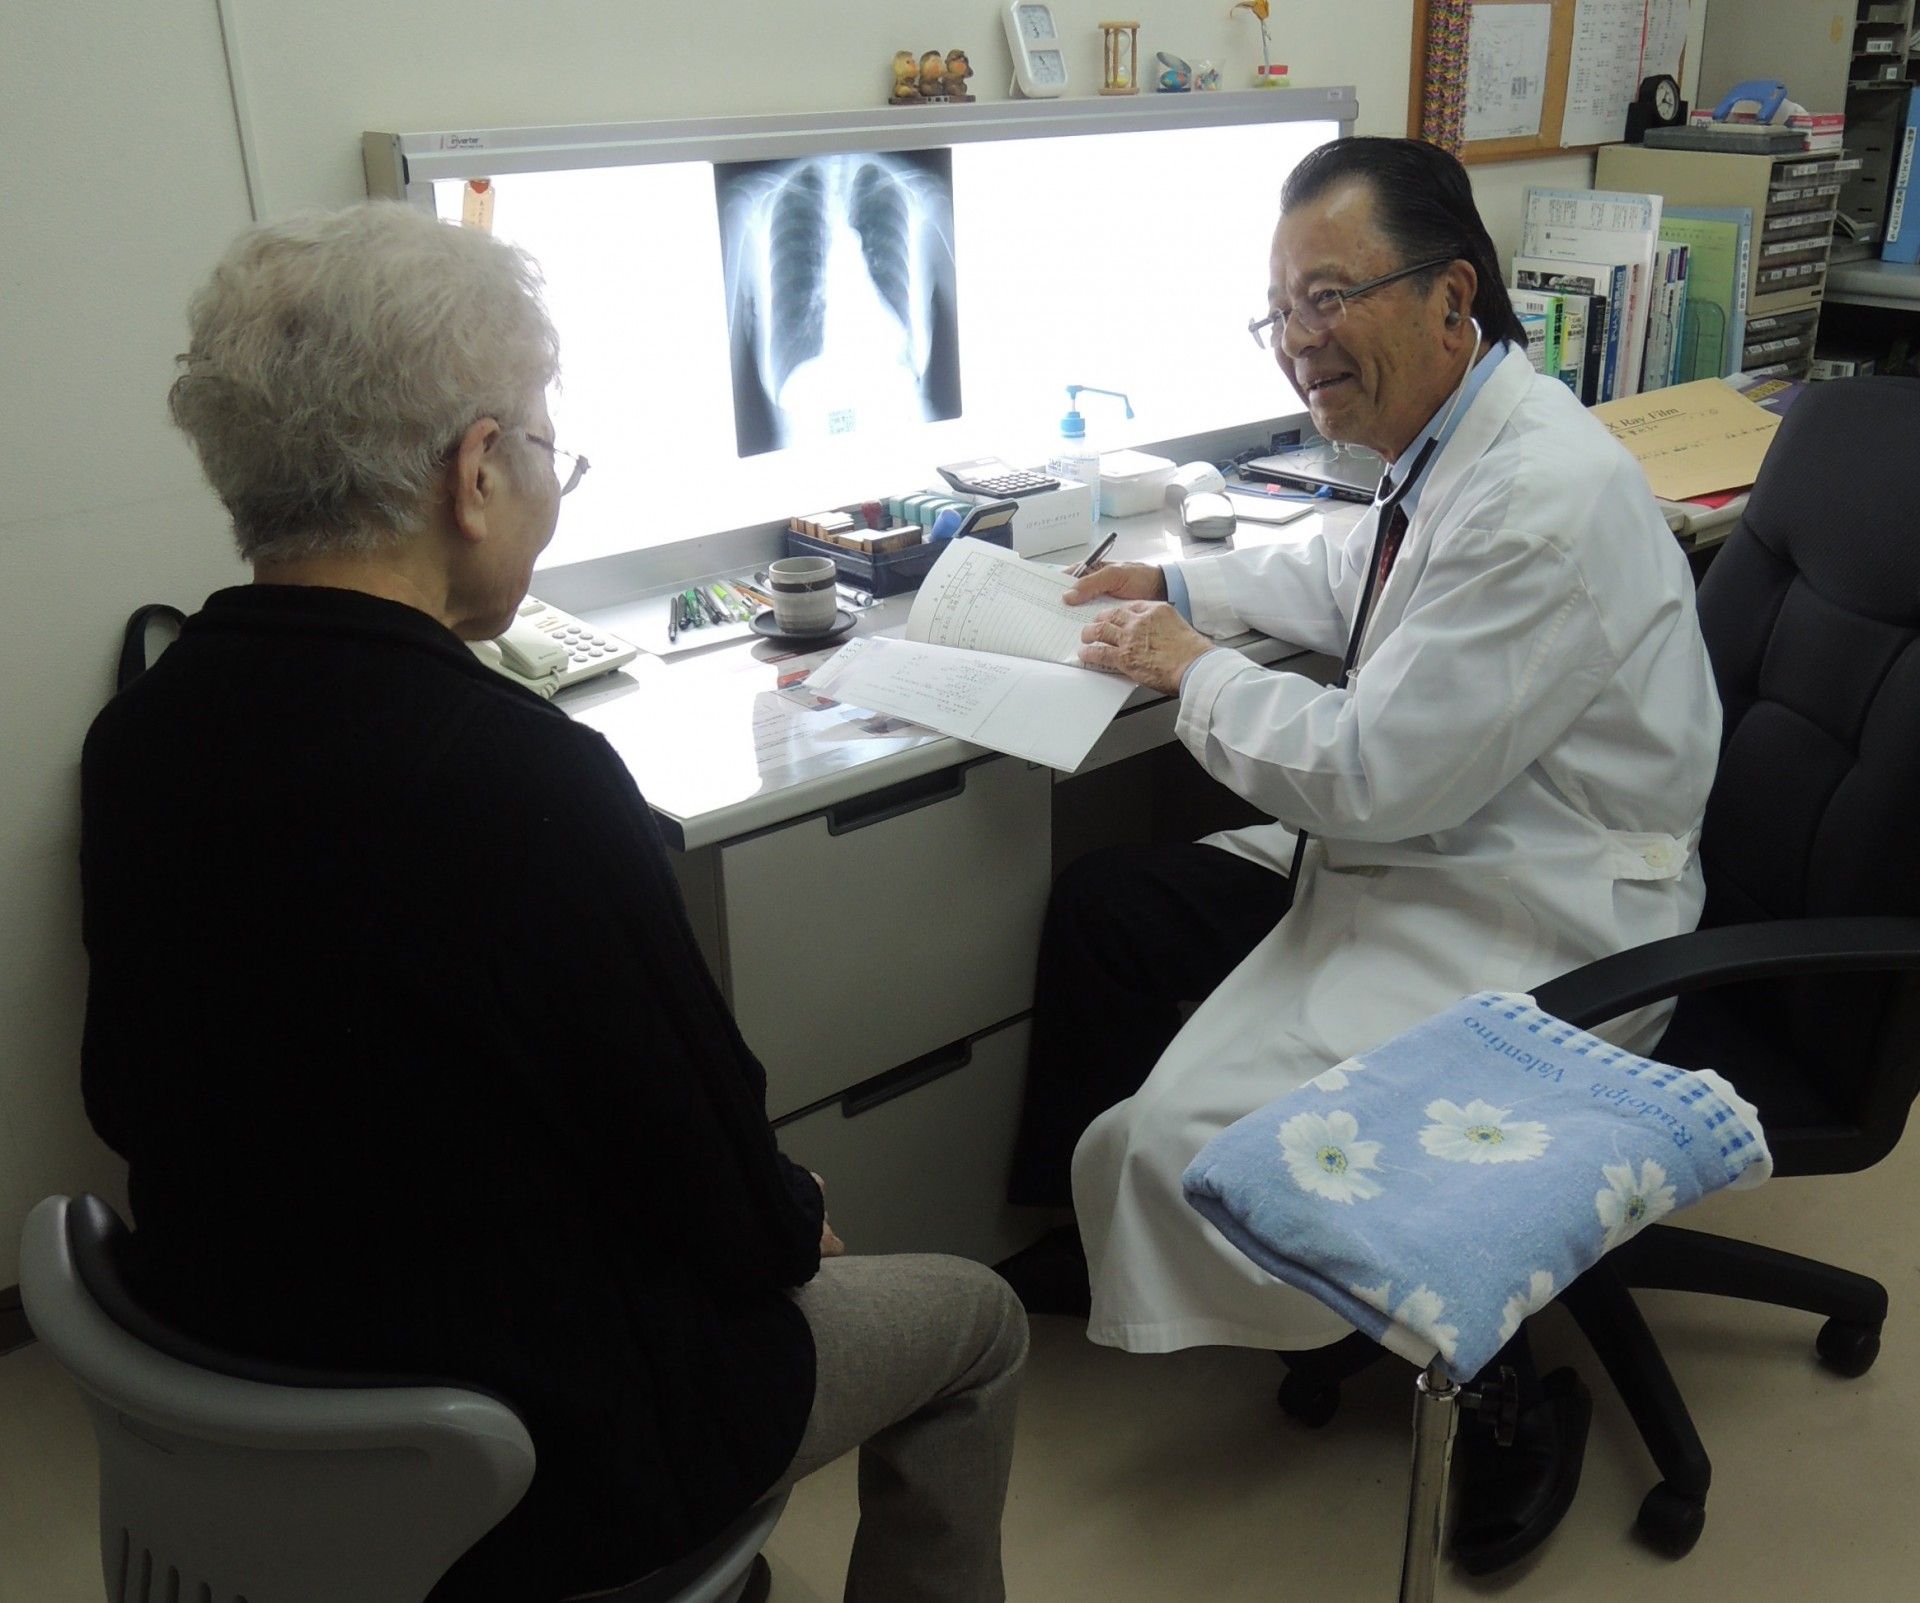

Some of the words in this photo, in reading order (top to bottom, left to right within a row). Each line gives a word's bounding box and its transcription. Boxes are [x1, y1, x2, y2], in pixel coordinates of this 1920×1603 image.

[1620, 416, 1646, 428] Ray
[1647, 407, 1680, 420] Film
[1463, 1015, 1565, 1083] Valentino
[1590, 1082, 1693, 1148] Rudolph
